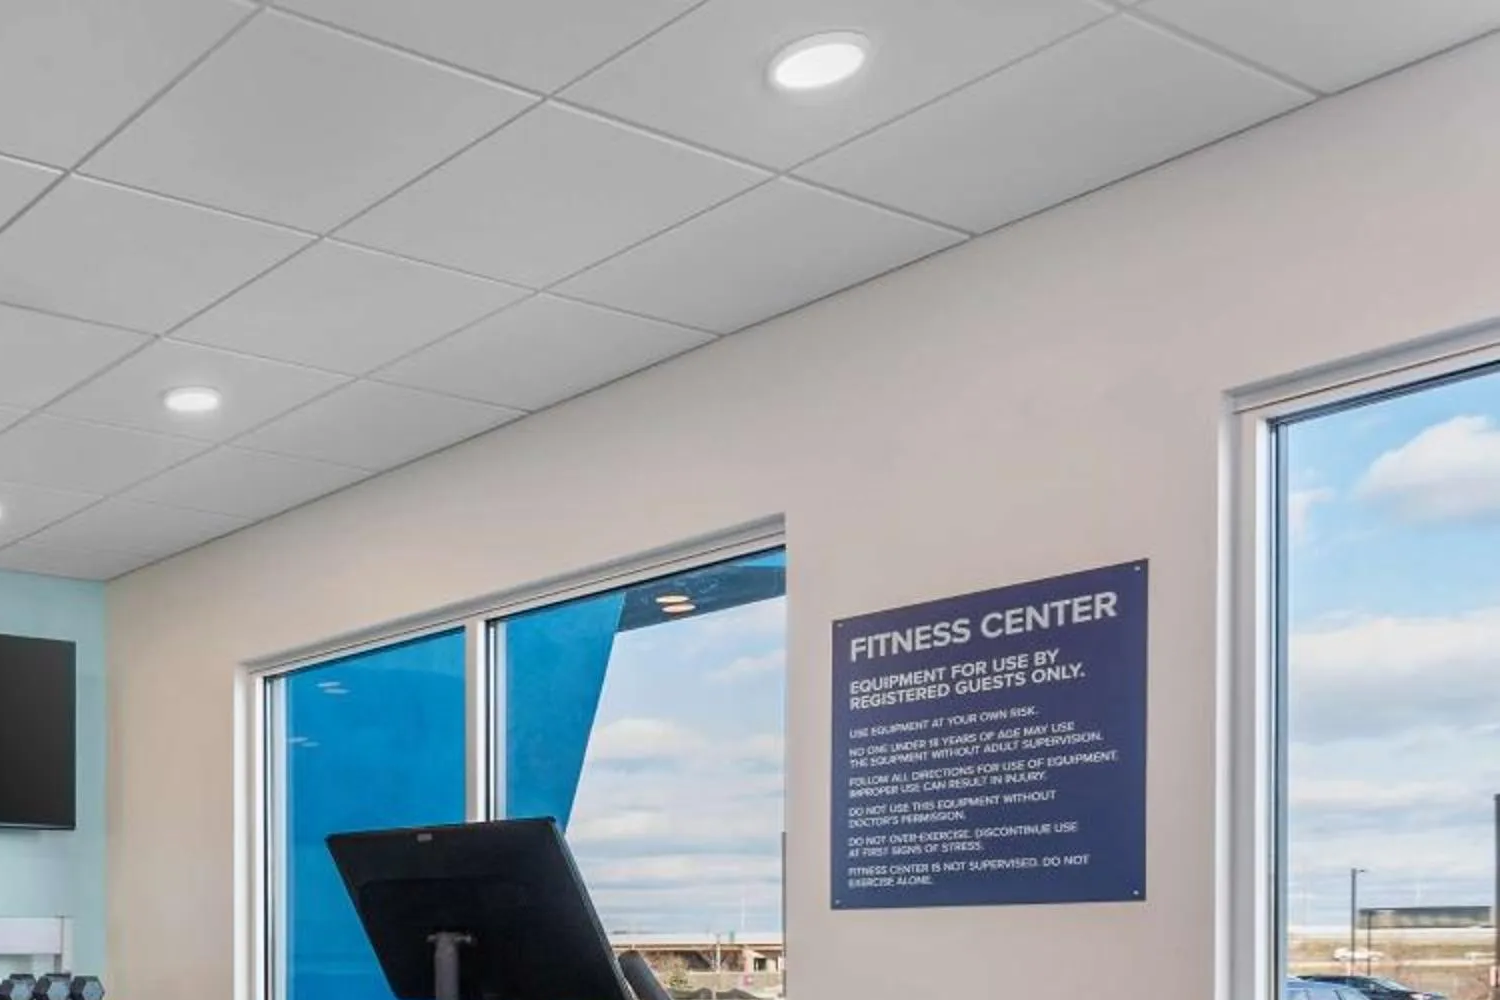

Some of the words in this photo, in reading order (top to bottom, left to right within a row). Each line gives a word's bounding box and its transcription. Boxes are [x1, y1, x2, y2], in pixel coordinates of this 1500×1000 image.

[850, 618, 972, 663] FITNESS
[980, 591, 1118, 638] CENTER
[850, 667, 946, 694] EQUIPMENT
[951, 660, 988, 680] FOR
[992, 653, 1029, 673] USE
[1034, 648, 1060, 667] BY
[850, 683, 950, 710] REGISTERED
[955, 670, 1026, 695] GUESTS
[1031, 662, 1087, 683] ONLY.
[871, 720, 929, 737] EQUIPMENT
[931, 717, 943, 728] AT
[948, 712, 977, 726] YOUR
[980, 709, 1007, 723] OWN
[850, 747, 864, 757] NO
[892, 739, 926, 753] UNDER
[941, 732, 977, 746] YEARS
[980, 731, 995, 742] OF
[1024, 724, 1049, 736] MAY
[1051, 721, 1075, 733] USE
[850, 758, 868, 769] THE
[870, 752, 928, 767] EQUIPMENT
[931, 745, 980, 760] WITHOUT
[984, 739, 1020, 753] ADULT
[850, 774, 889, 787] FOLLOW
[891, 772, 909, 783] ALL
[912, 765, 975, 781] DIRECTIONS
[977, 763, 1000, 774] FOR
[1002, 760, 1025, 771] USE
[1028, 757, 1045, 769] OF
[850, 785, 898, 799] IMPROPER
[901, 783, 921, 793] USE
[923, 780, 946, 791] CAN
[948, 776, 987, 788] RESULT
[990, 775, 1002, 785] IN
[849, 807, 863, 817] DO
[866, 804, 886, 815] NOT
[889, 802, 910, 813] USE
[912, 801, 935, 812] THIS
[937, 795, 1000, 810] EQUIPMENT
[1003, 790, 1057, 804] WITHOUT
[849, 837, 864, 847] DO
[866, 835, 886, 845] NOT
[975, 823, 1052, 839] DISCONTINUE
[1053, 821, 1079, 833] USE
[849, 848, 860, 857] AT
[862, 846, 889, 857] FIRST
[891, 844, 922, 855] SIGNS
[925, 843, 939, 853] OF
[849, 865, 887, 877] FITNESS
[890, 863, 929, 875] CENTER
[932, 862, 941, 872] IS
[943, 861, 966, 872] NOT
[1042, 856, 1061, 867] DO
[1064, 854, 1090, 866] NOT
